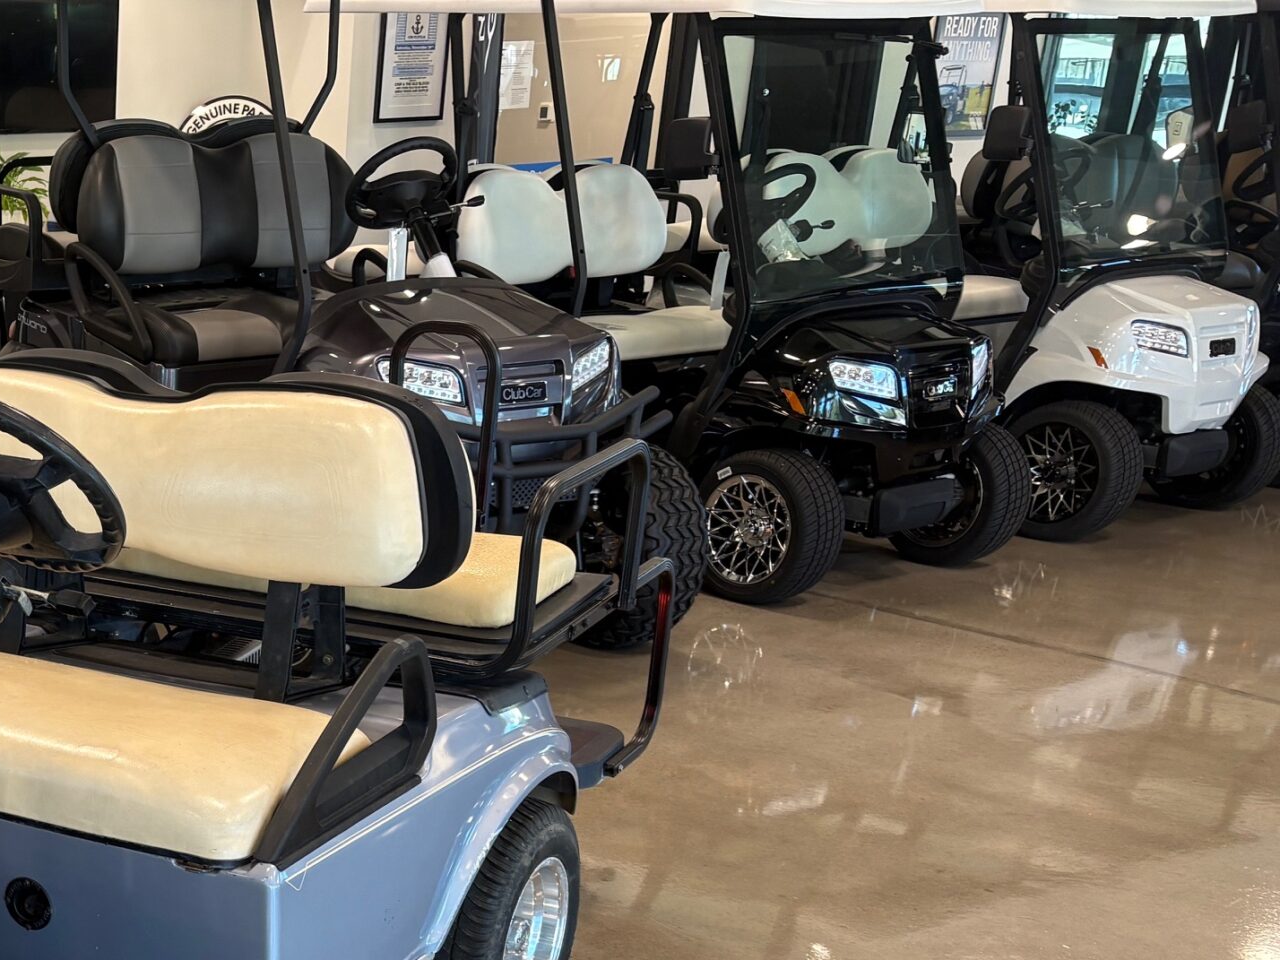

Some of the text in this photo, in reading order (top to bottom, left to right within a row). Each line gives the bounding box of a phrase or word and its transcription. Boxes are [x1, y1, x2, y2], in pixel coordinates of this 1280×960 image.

[943, 15, 999, 38] READY FOR
[186, 103, 240, 134] GENUINE
